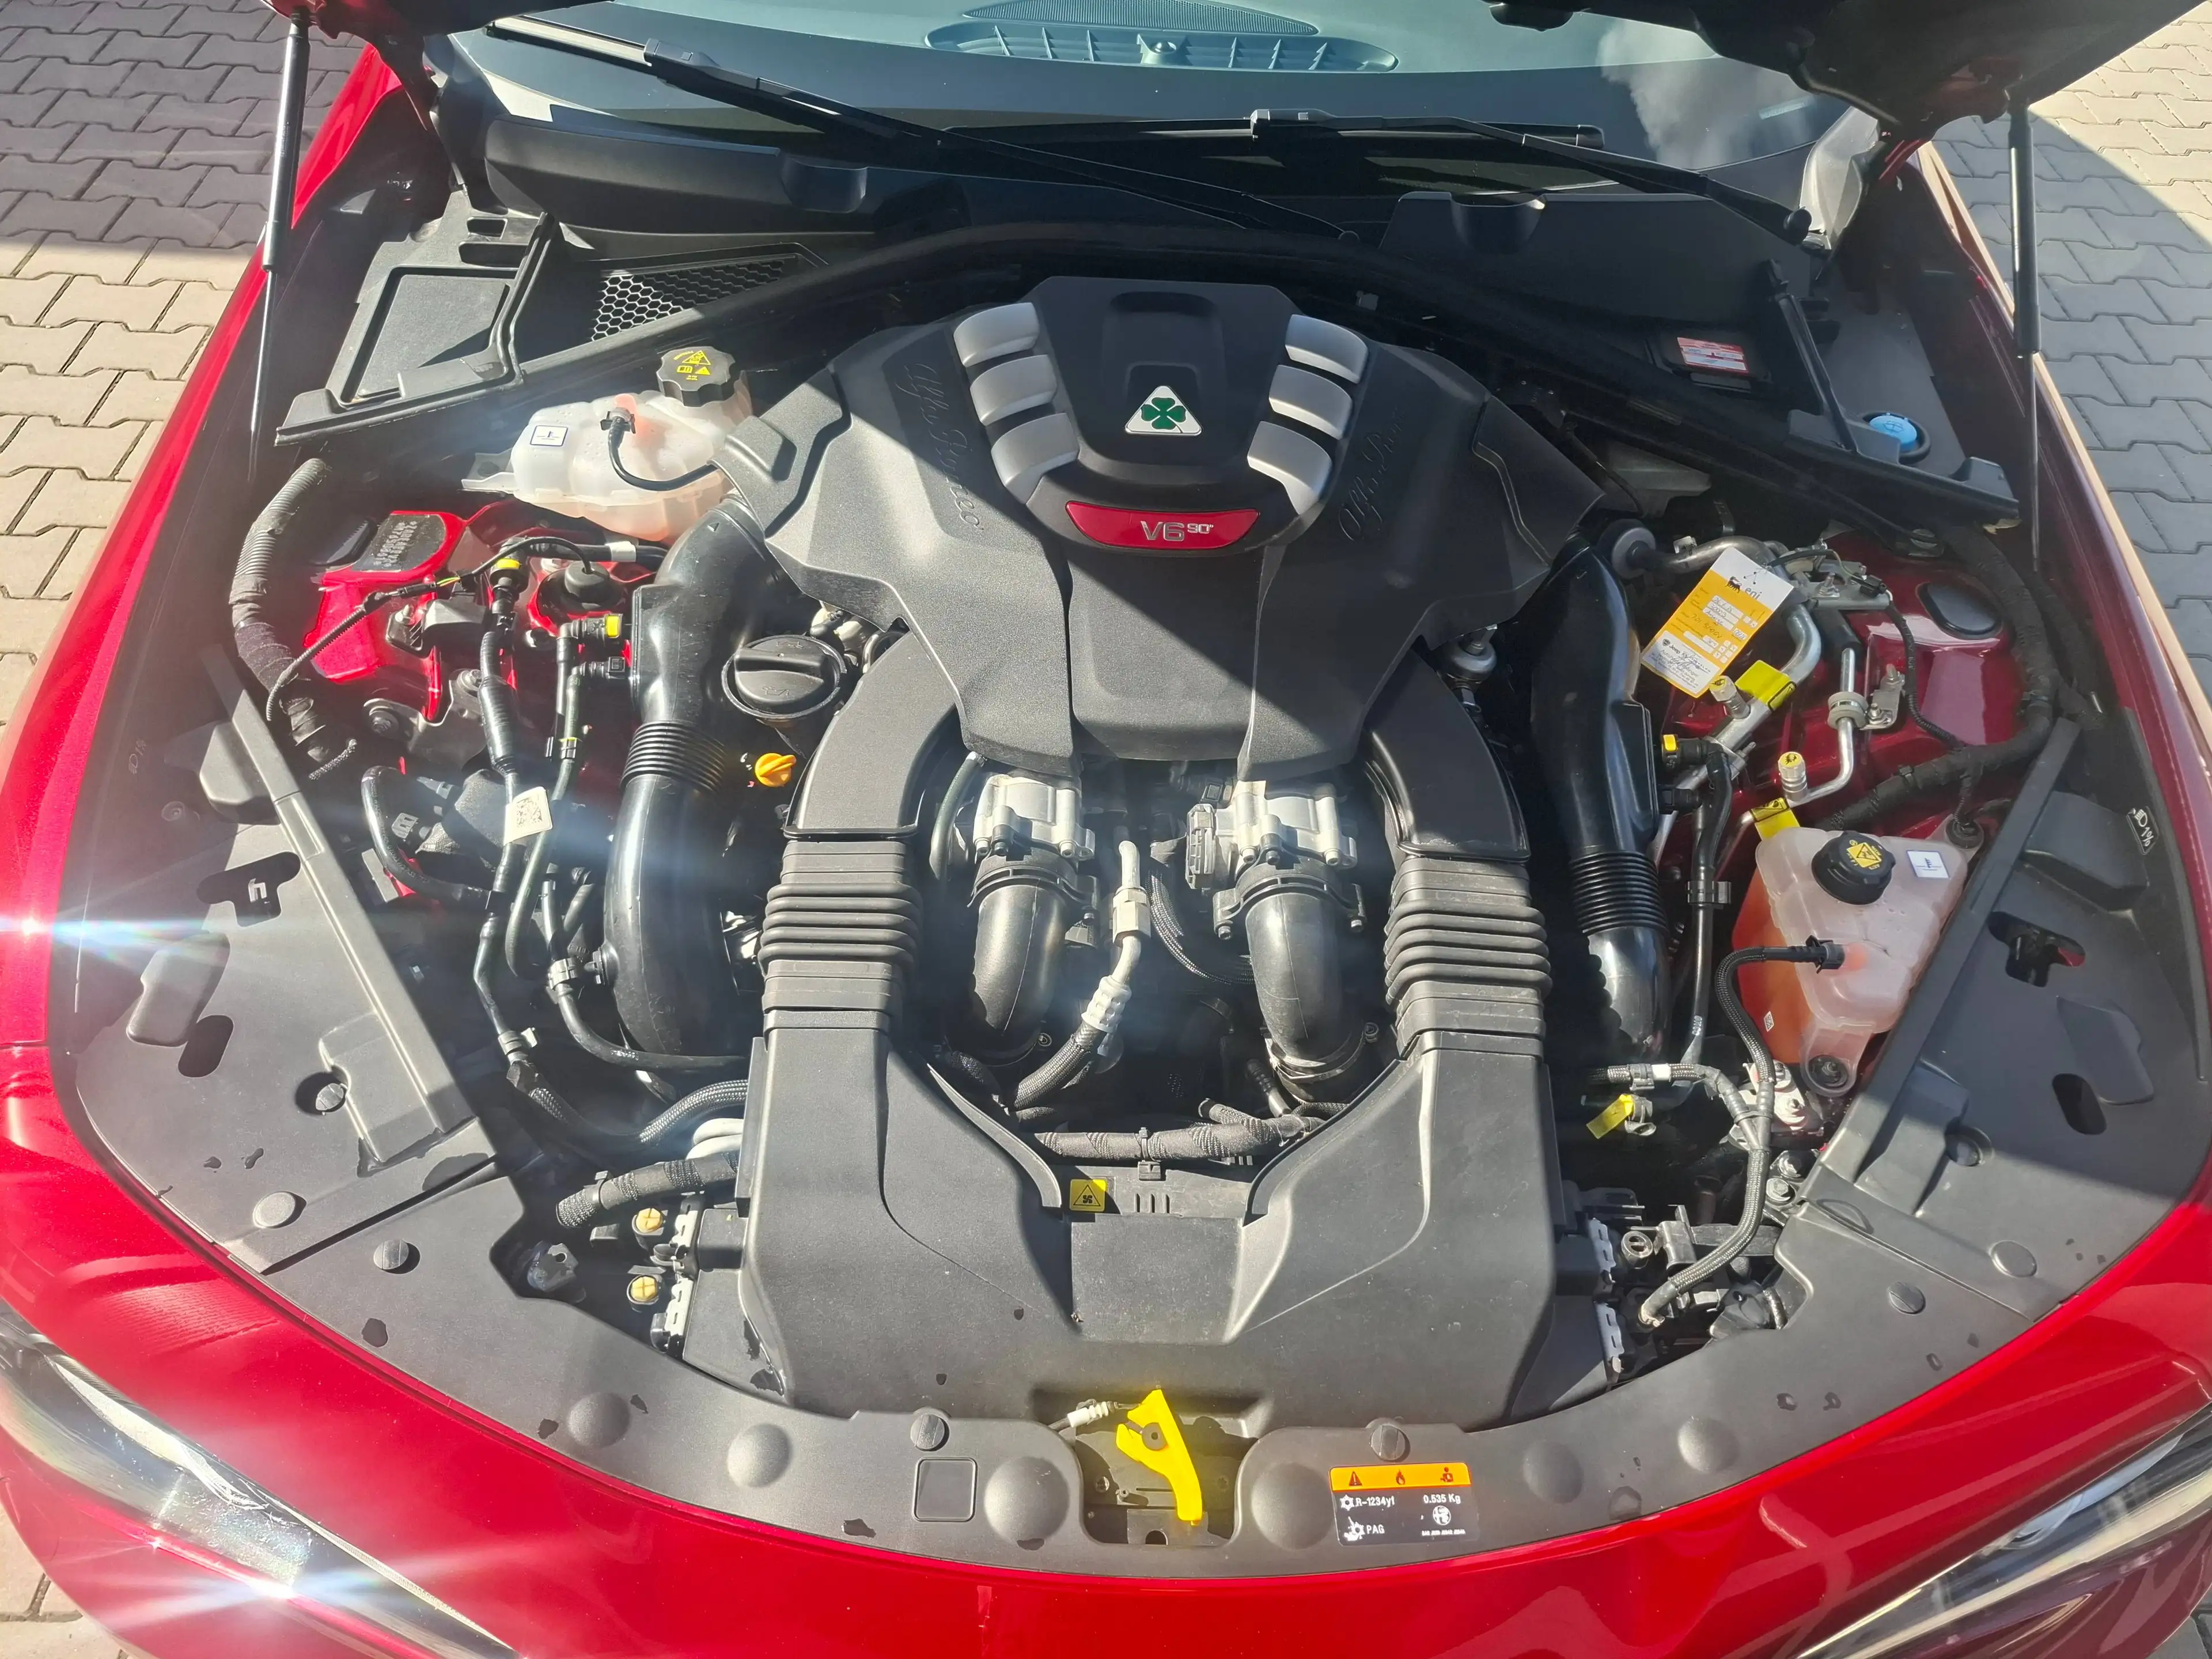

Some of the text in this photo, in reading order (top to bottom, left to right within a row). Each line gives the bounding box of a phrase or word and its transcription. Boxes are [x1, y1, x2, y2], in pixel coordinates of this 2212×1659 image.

[1139, 520, 1185, 542] V6
[1744, 587, 1763, 600] eni
[1668, 645, 1681, 654] Jeep
[1423, 1493, 1461, 1505] 0.535 Kg
[1366, 1524, 1385, 1535] PAG
